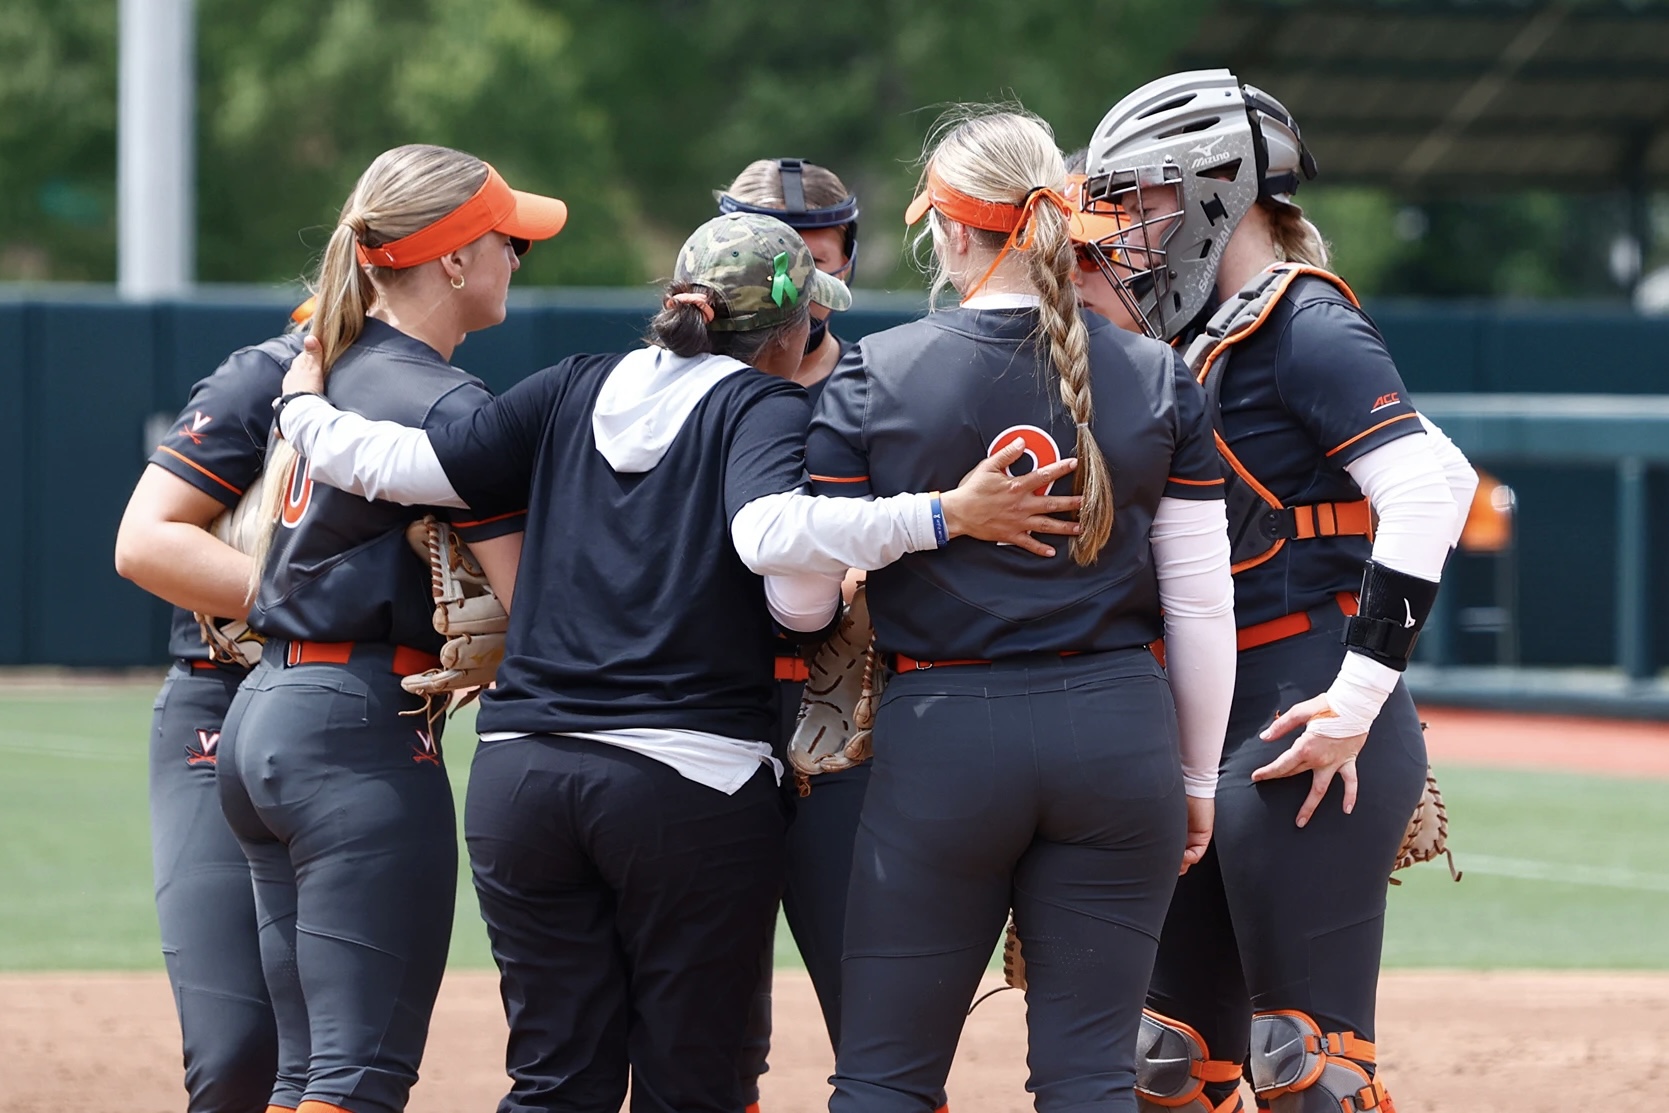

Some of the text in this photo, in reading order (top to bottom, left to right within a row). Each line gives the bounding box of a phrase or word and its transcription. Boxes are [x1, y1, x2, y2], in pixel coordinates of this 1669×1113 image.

[1191, 151, 1230, 169] MIZUNO
[1198, 224, 1231, 293] SAMURAI
[1372, 392, 1400, 409] ACC
